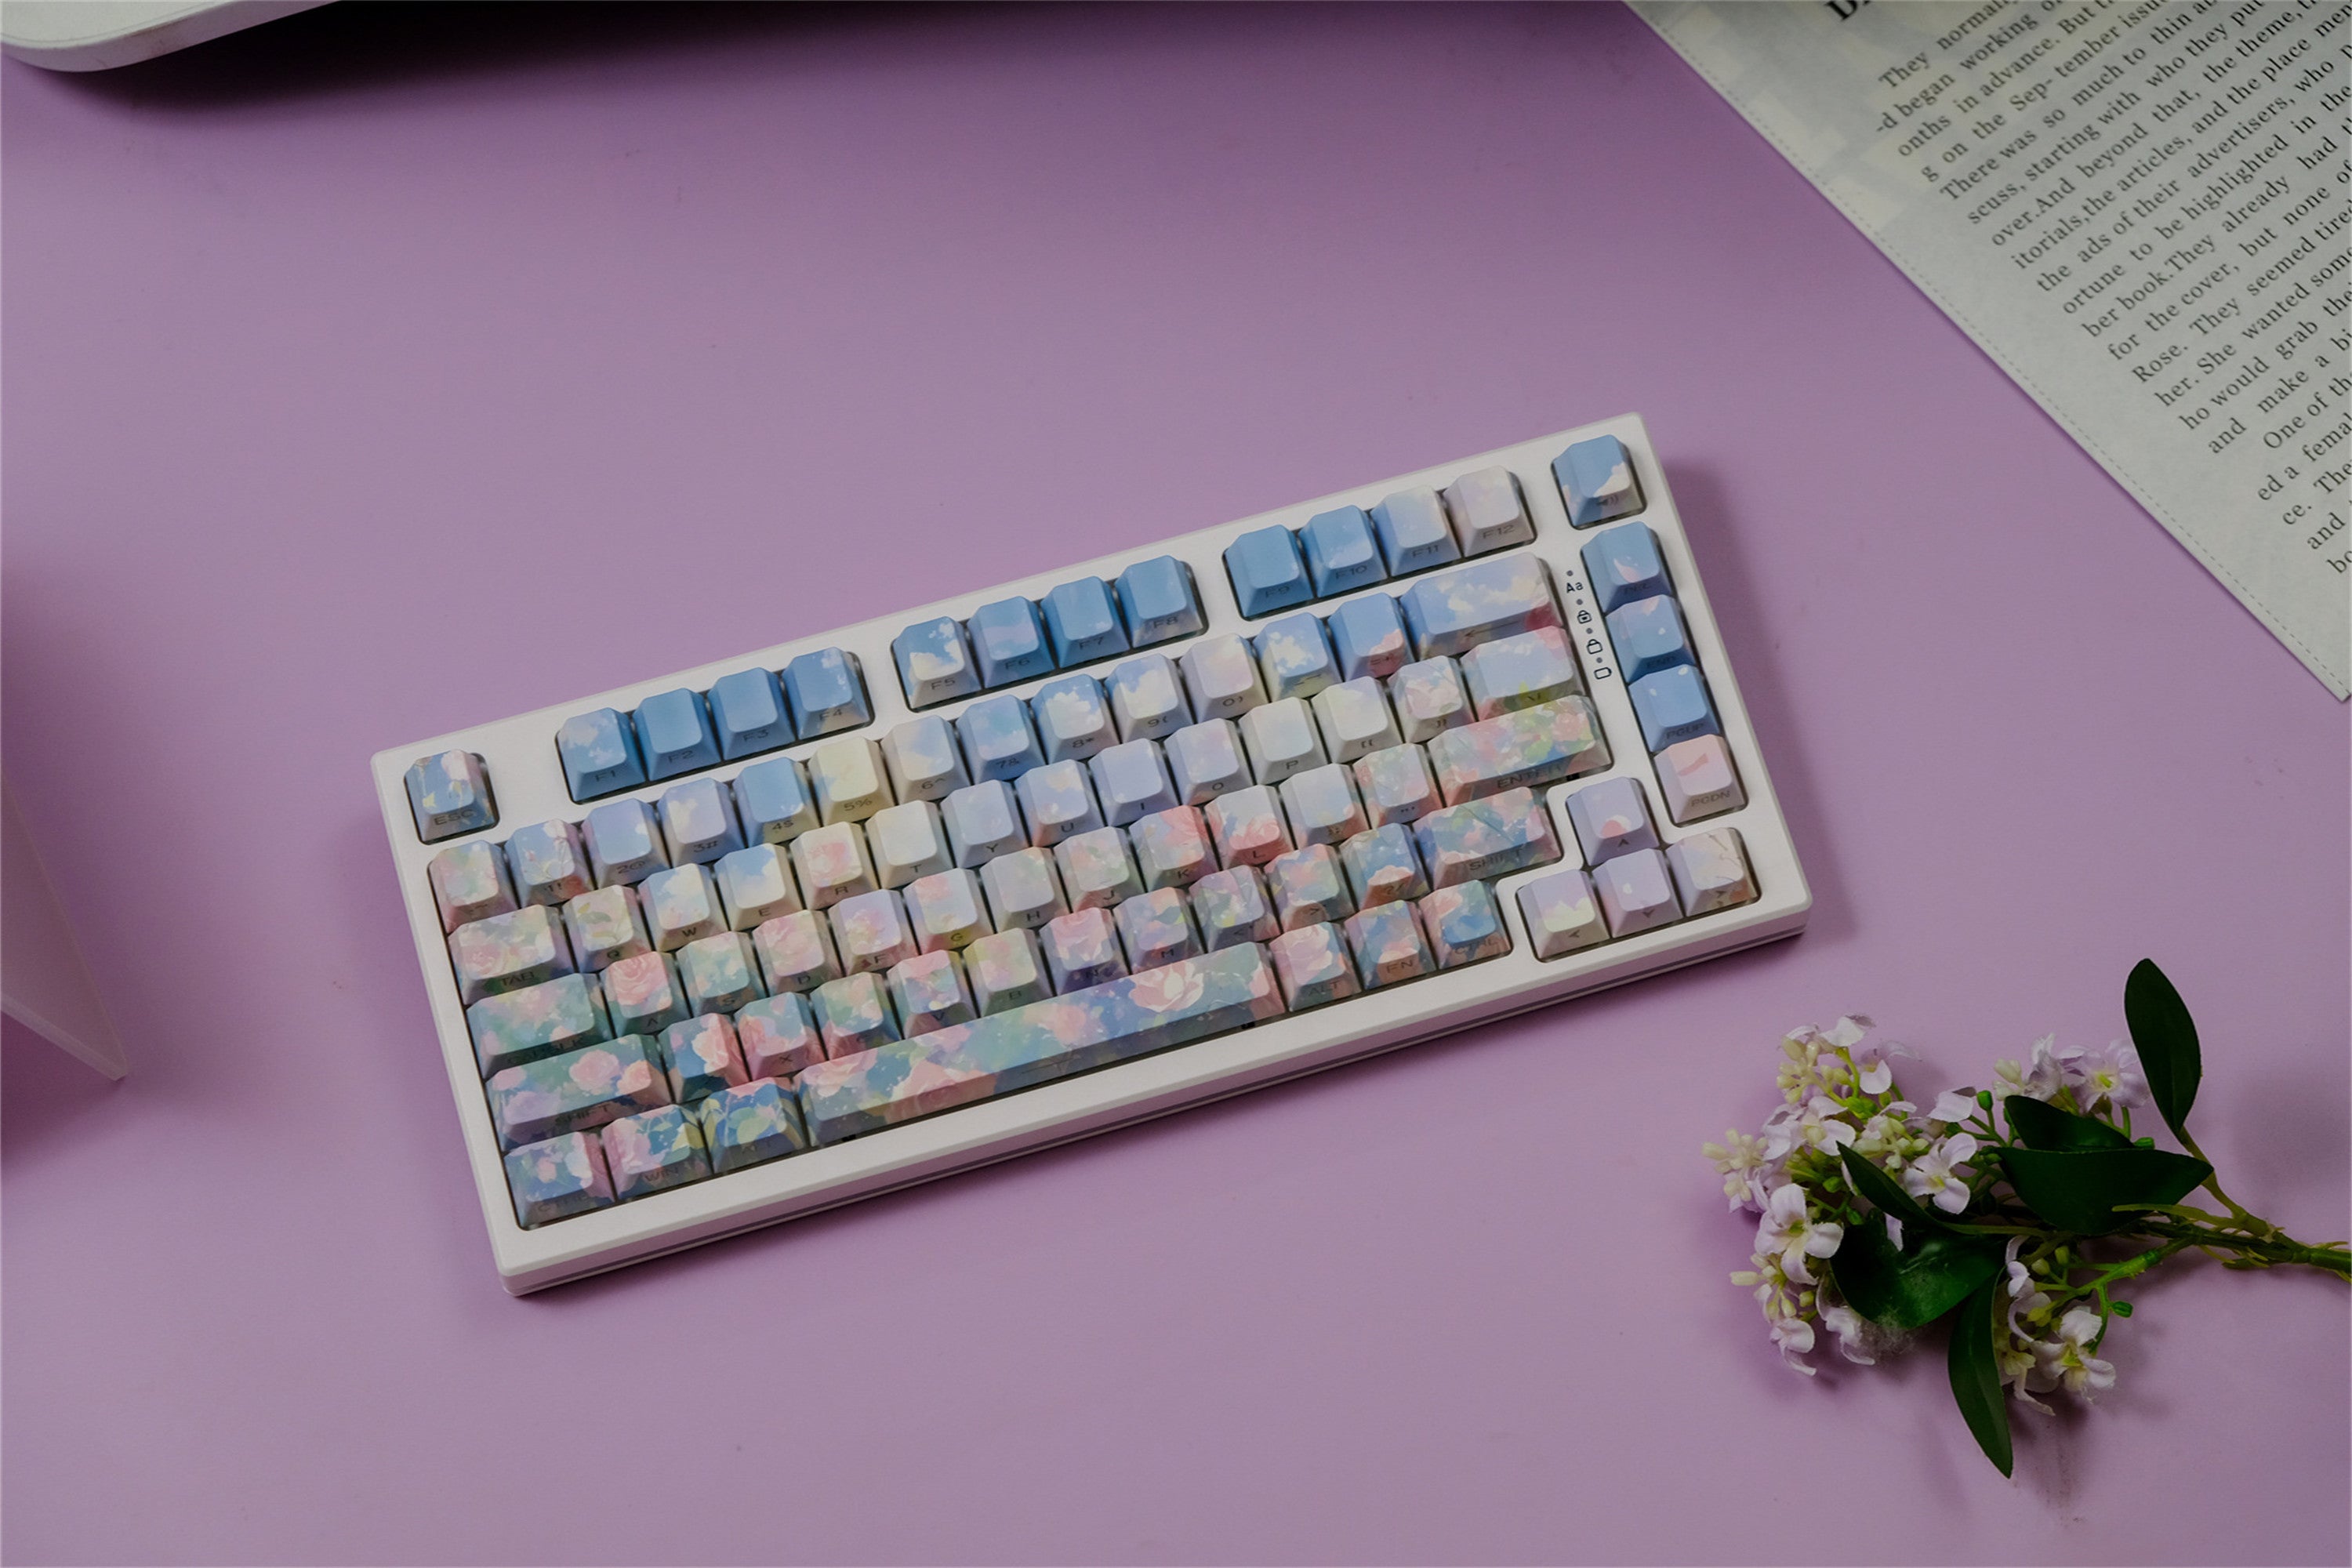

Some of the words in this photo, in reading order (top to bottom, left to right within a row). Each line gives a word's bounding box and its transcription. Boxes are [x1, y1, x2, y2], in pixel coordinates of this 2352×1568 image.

[1878, 53, 1927, 88] They
[1893, 74, 1955, 118] began
[1960, 14, 2038, 70] working
[1898, 116, 1951, 157] onths
[1953, 96, 1980, 114] in
[1980, 38, 2060, 96] advance.
[2057, 6, 2096, 34] But
[1922, 166, 1939, 183] g
[1942, 143, 1969, 163] on
[1972, 114, 2005, 140] the
[2009, 79, 2053, 111] Sep-
[2054, 26, 2120, 78] tember
[1939, 158, 1999, 200] There
[1999, 130, 2037, 158] was
[2042, 109, 2066, 129] so
[2071, 64, 2125, 106] much
[2122, 48, 2147, 66] to
[2150, 13, 2193, 45] thin
[2075, 122, 2149, 179] beyond
[2151, 90, 2201, 123] that,
[2202, 56, 2237, 84] the
[2117, 136, 2193, 191] articles,
[2191, 100, 2229, 134] and
[2226, 78, 2261, 105] the
[2260, 38, 2311, 83] place
[1968, 183, 2027, 224] scuss,
[2024, 125, 2100, 181] starting
[2097, 92, 2141, 125] with
[2146, 56, 2186, 87] who
[2184, 23, 2228, 57] they
[2036, 265, 2071, 292] the
[2078, 234, 2111, 263] ads
[2113, 211, 2135, 235] of
[2132, 180, 2180, 218] their
[2187, 97, 2296, 178] advertisers,
[2293, 61, 2335, 93] who
[2063, 264, 2125, 314] ortune
[2129, 243, 2153, 261] to
[2154, 220, 2183, 240] be
[2180, 133, 2289, 220] highlighted
[2290, 116, 2318, 134] in
[2081, 308, 2119, 338] ber
[2221, 176, 2290, 233] already
[2296, 136, 2339, 170] had
[2107, 333, 2140, 361] for
[2144, 304, 2180, 332] the
[2180, 263, 2240, 306] cover,
[2238, 227, 2278, 257] but
[2282, 187, 2330, 226] none
[2131, 345, 2188, 383] Rose.
[2188, 298, 2240, 335] They
[2246, 235, 2317, 296] seemed
[2154, 377, 2200, 407] her.
[2197, 344, 2237, 375] She
[2241, 281, 2311, 339] wanted
[2178, 407, 2210, 430] ho
[2209, 356, 2270, 406] would
[2274, 321, 2318, 361] grab
[2208, 416, 2247, 454] and
[2256, 371, 2309, 413] make
[2314, 355, 2331, 368] a
[2263, 416, 2306, 449] One
[2307, 391, 2329, 417] of
[2257, 474, 2285, 501] ed
[2284, 466, 2300, 480] a
[2282, 504, 2312, 525] ce.
[1483, 525, 1515, 539] F12
[2307, 511, 2347, 550] and
[1411, 545, 1439, 557] F11
[1153, 617, 1178, 629] F8
[1078, 637, 1105, 649] F7
[1005, 657, 1029, 670] F6
[931, 678, 955, 690] F5
[819, 710, 842, 721] F4
[743, 730, 769, 742] F3
[1667, 723, 1704, 739] PGUP
[668, 751, 693, 763] F2
[1286, 760, 1298, 770] P
[594, 771, 616, 782] F1
[1496, 764, 1562, 787] ENTER
[1690, 790, 1730, 807] PGDN
[434, 810, 474, 826] ESC
[1061, 822, 1075, 833] U
[985, 844, 998, 853] Y
[1468, 849, 1523, 870] SHIFT
[1177, 869, 1191, 879] K
[1103, 891, 1115, 900] J
[1026, 911, 1040, 921] H
[682, 927, 697, 938] W
[950, 933, 964, 942] G
[1386, 960, 1413, 973] FN
[644, 1167, 680, 1182] WIN
